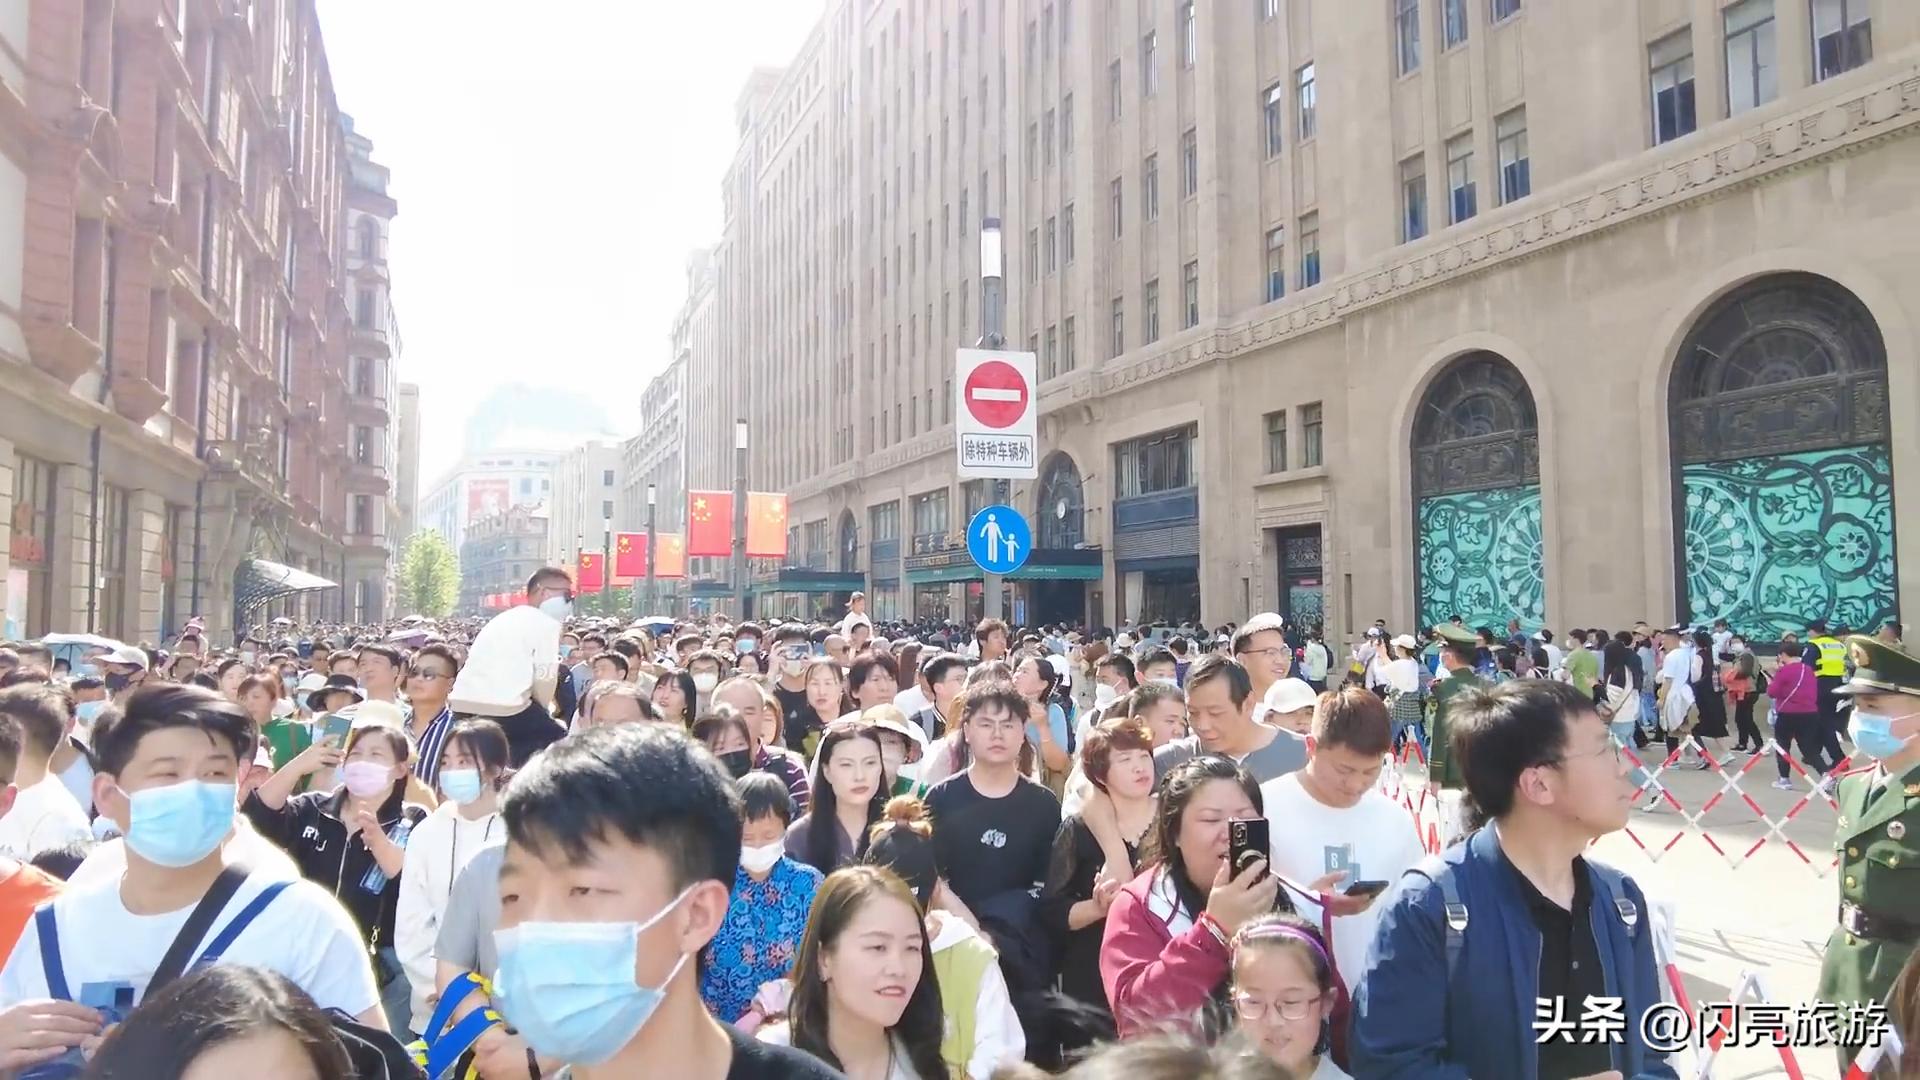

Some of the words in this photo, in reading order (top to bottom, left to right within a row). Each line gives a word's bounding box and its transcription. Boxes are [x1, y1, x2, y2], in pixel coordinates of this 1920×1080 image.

[964, 439, 1030, 462] 除特种车辆外
